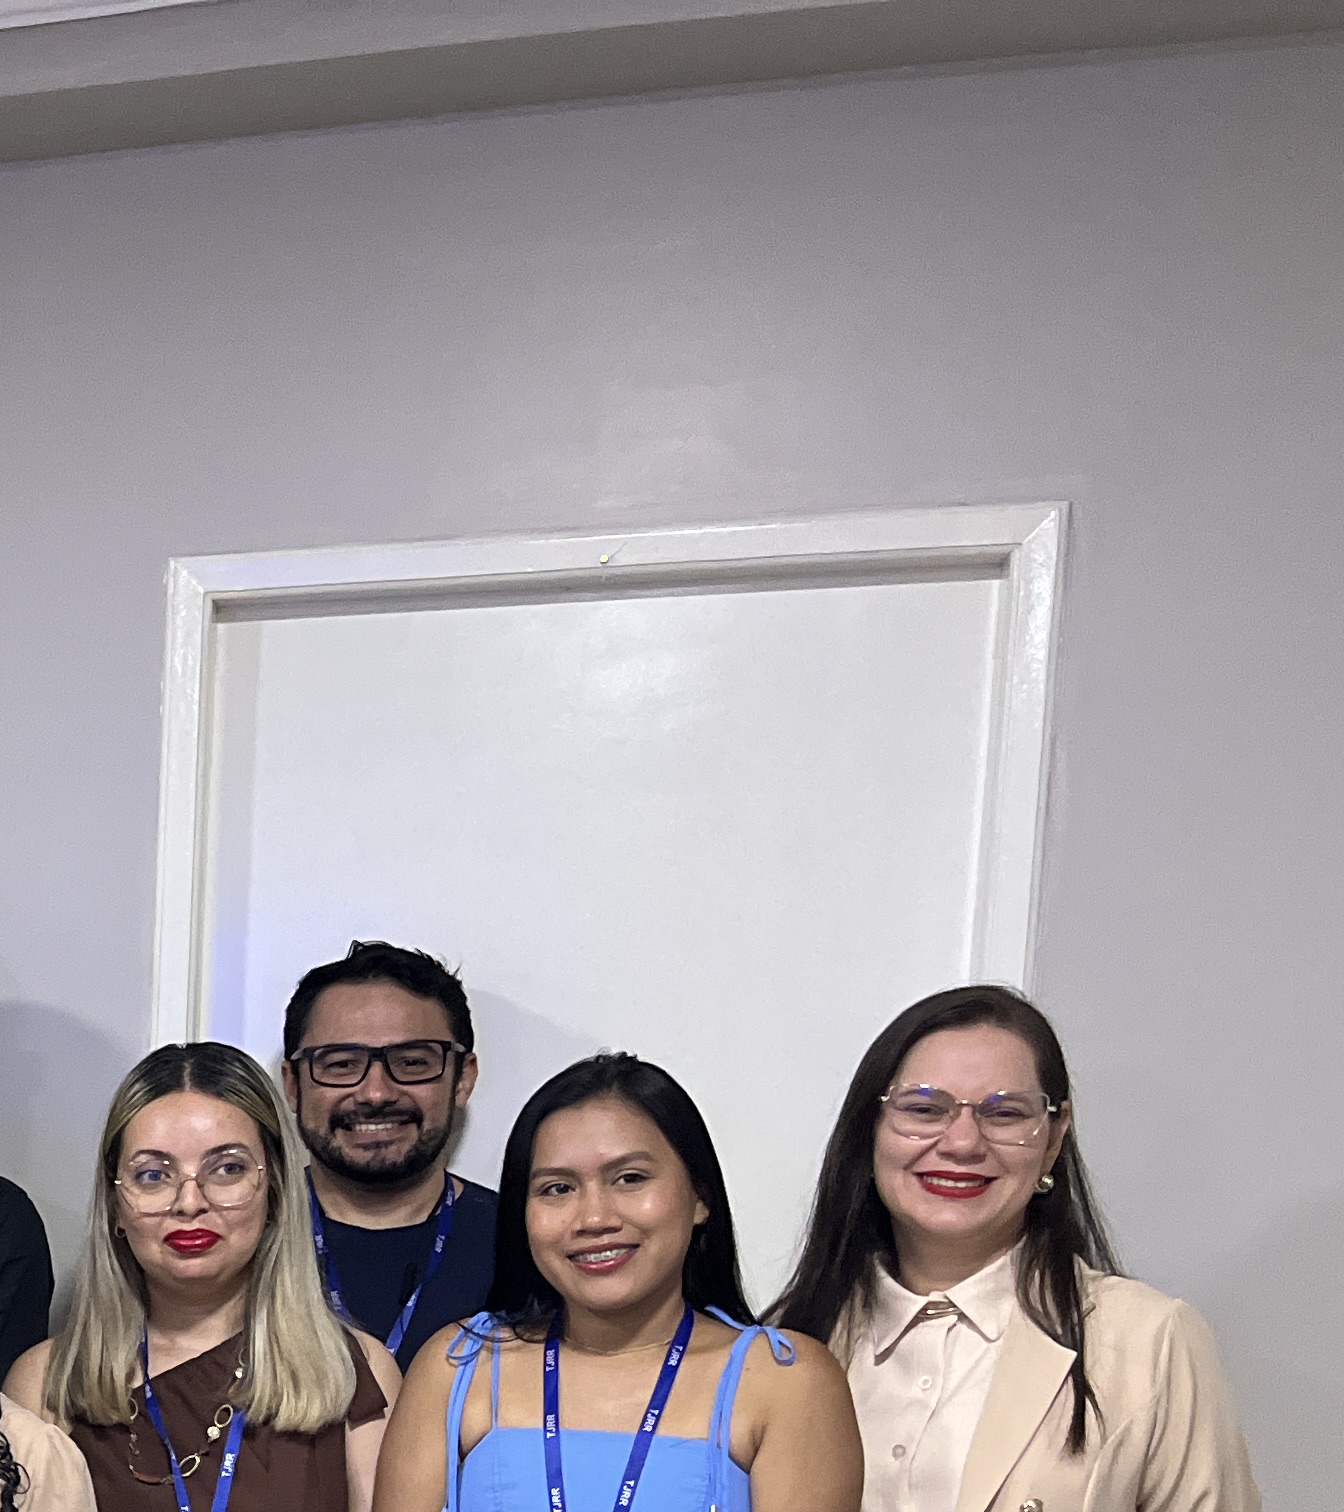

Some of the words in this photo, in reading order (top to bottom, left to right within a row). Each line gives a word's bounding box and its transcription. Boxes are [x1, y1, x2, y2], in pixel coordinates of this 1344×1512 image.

[546, 1349, 555, 1372] TJRR
[668, 1345, 683, 1366] TJRR
[547, 1414, 556, 1439] TJRR
[642, 1409, 659, 1432] TJRR
[221, 1453, 235, 1477] TJRR
[619, 1480, 634, 1506] TJRR
